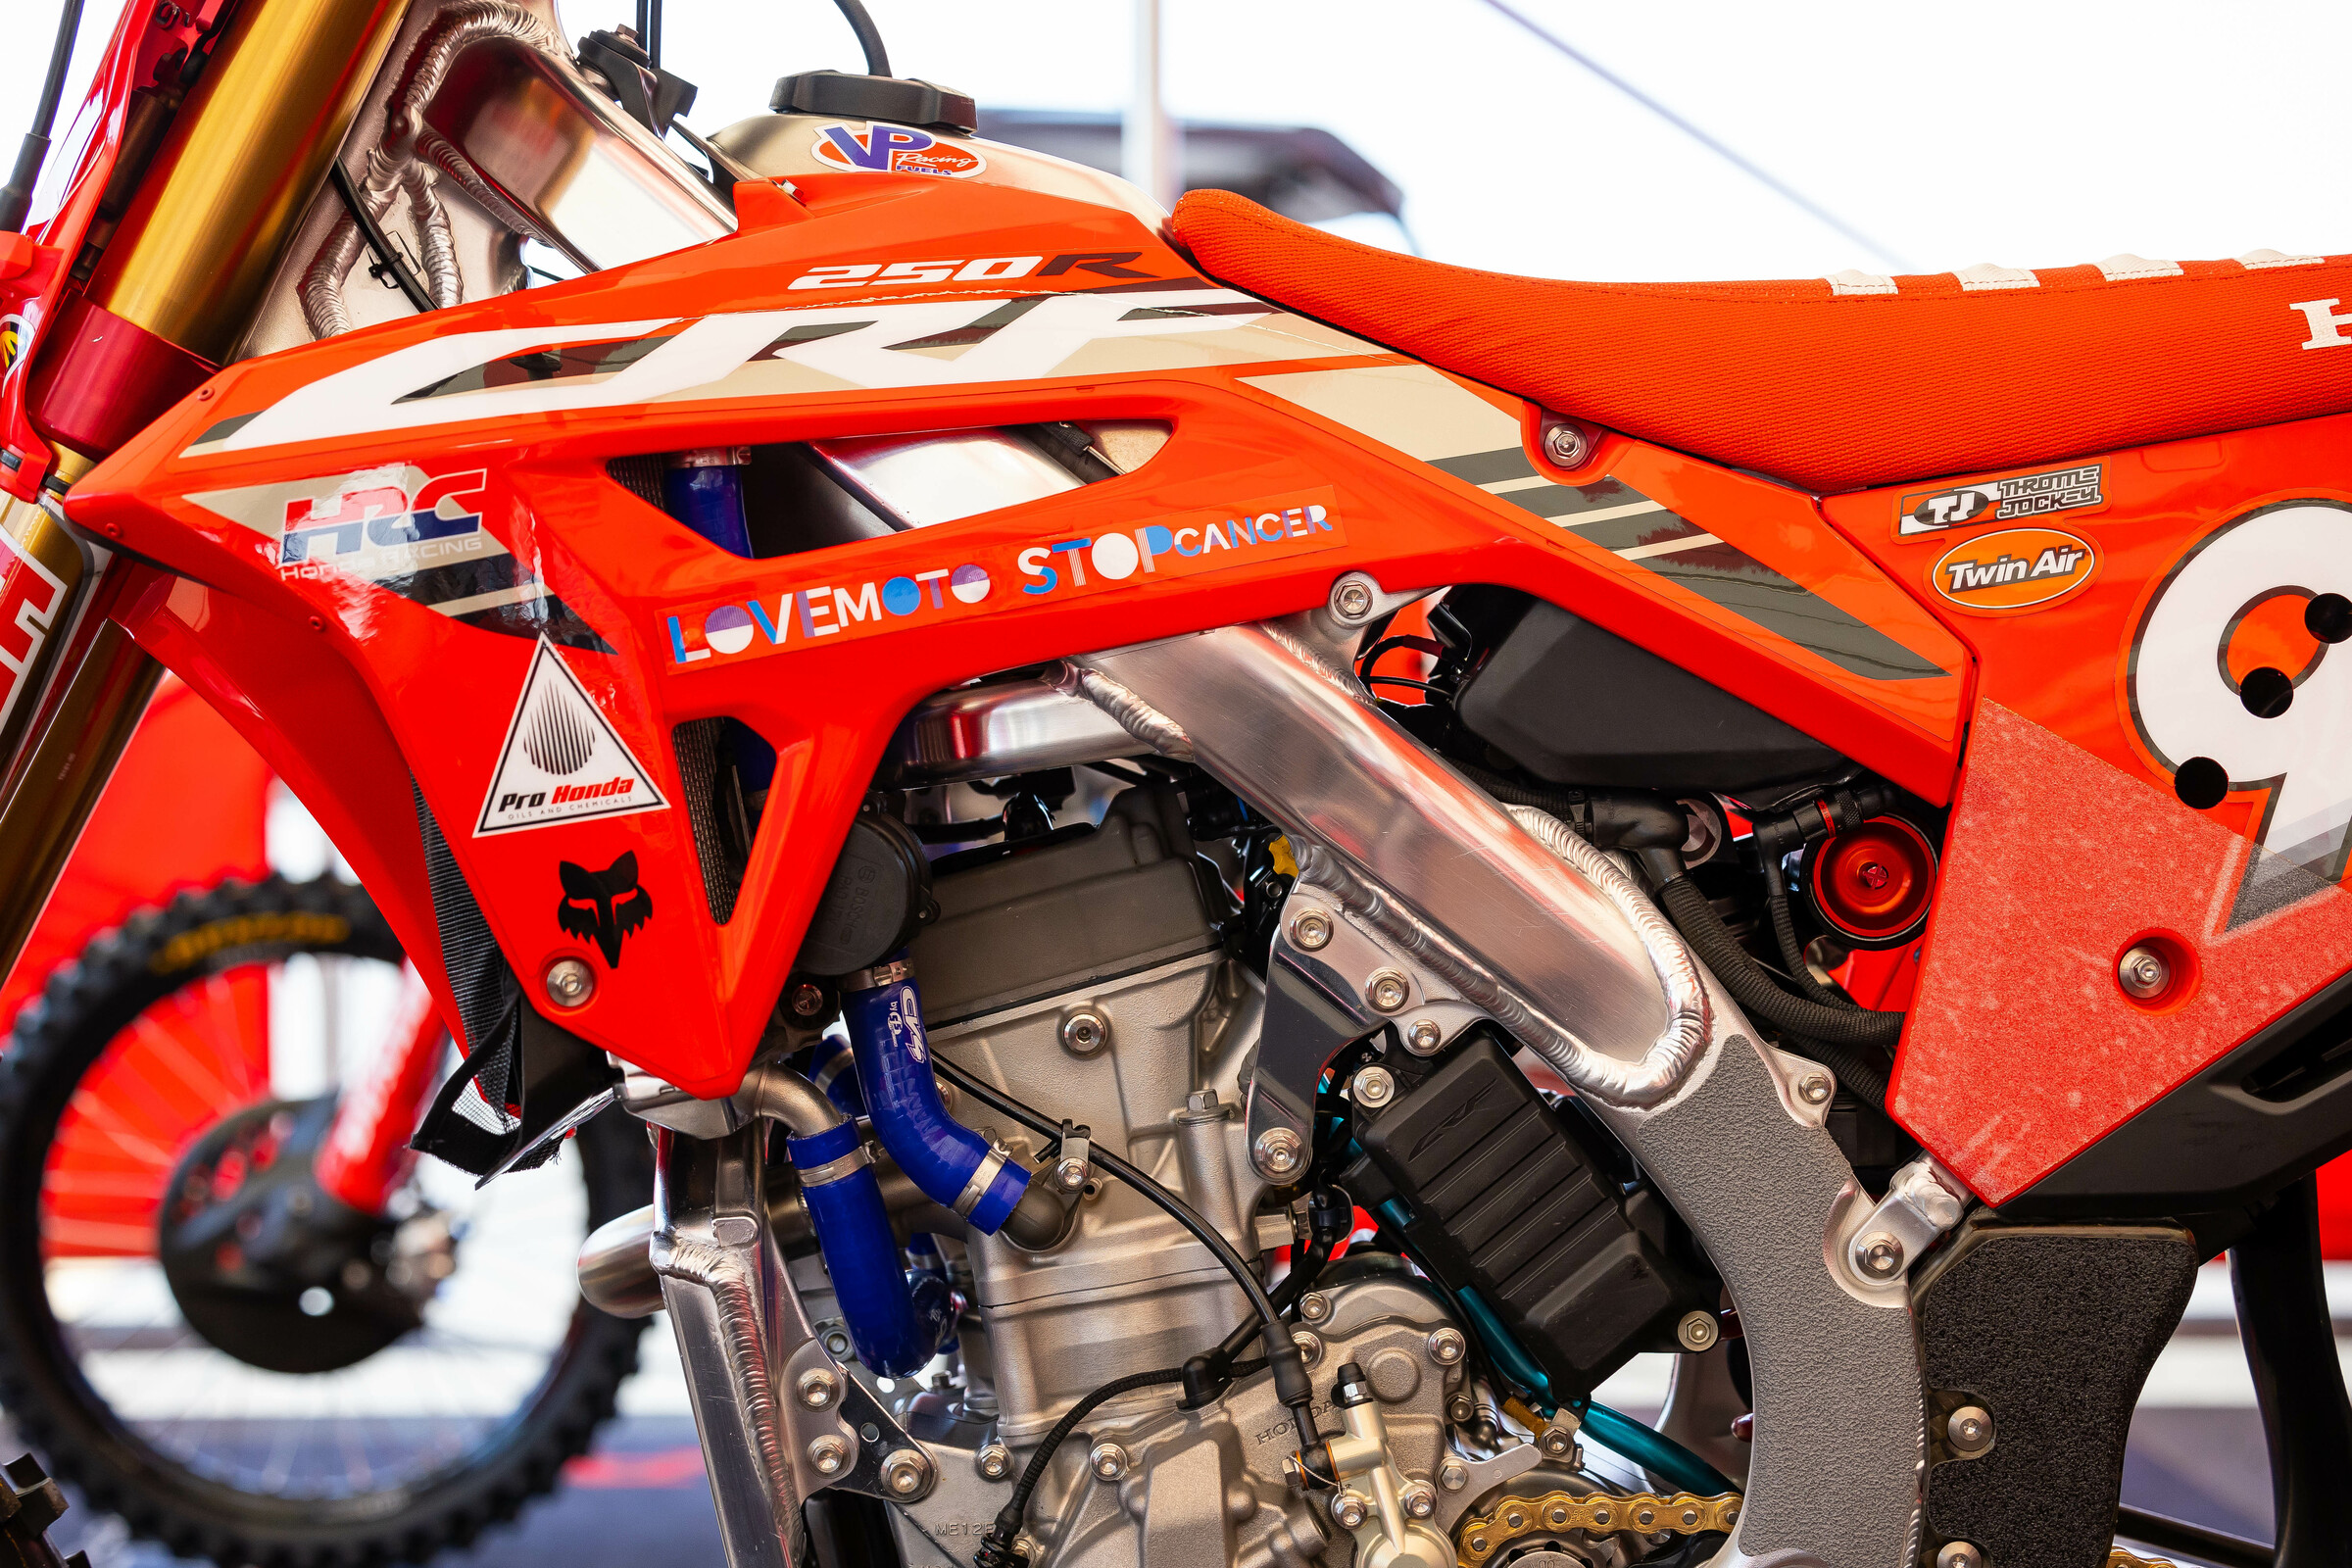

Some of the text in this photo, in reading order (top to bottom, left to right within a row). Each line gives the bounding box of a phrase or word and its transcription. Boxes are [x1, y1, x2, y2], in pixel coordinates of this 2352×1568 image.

[824, 124, 932, 171] VP
[896, 153, 978, 167] Racing
[896, 165, 952, 175] FUELS
[787, 252, 1161, 290] 250R
[280, 467, 487, 564] HRC
[1996, 486, 2101, 519] JOCKEY
[1948, 547, 2083, 590] Twin Air
[498, 776, 635, 813] Pro Honda
[508, 795, 633, 821] OILS AND CHEMICALS
[890, 1001, 899, 1011] by
[900, 986, 927, 1063] CV4
